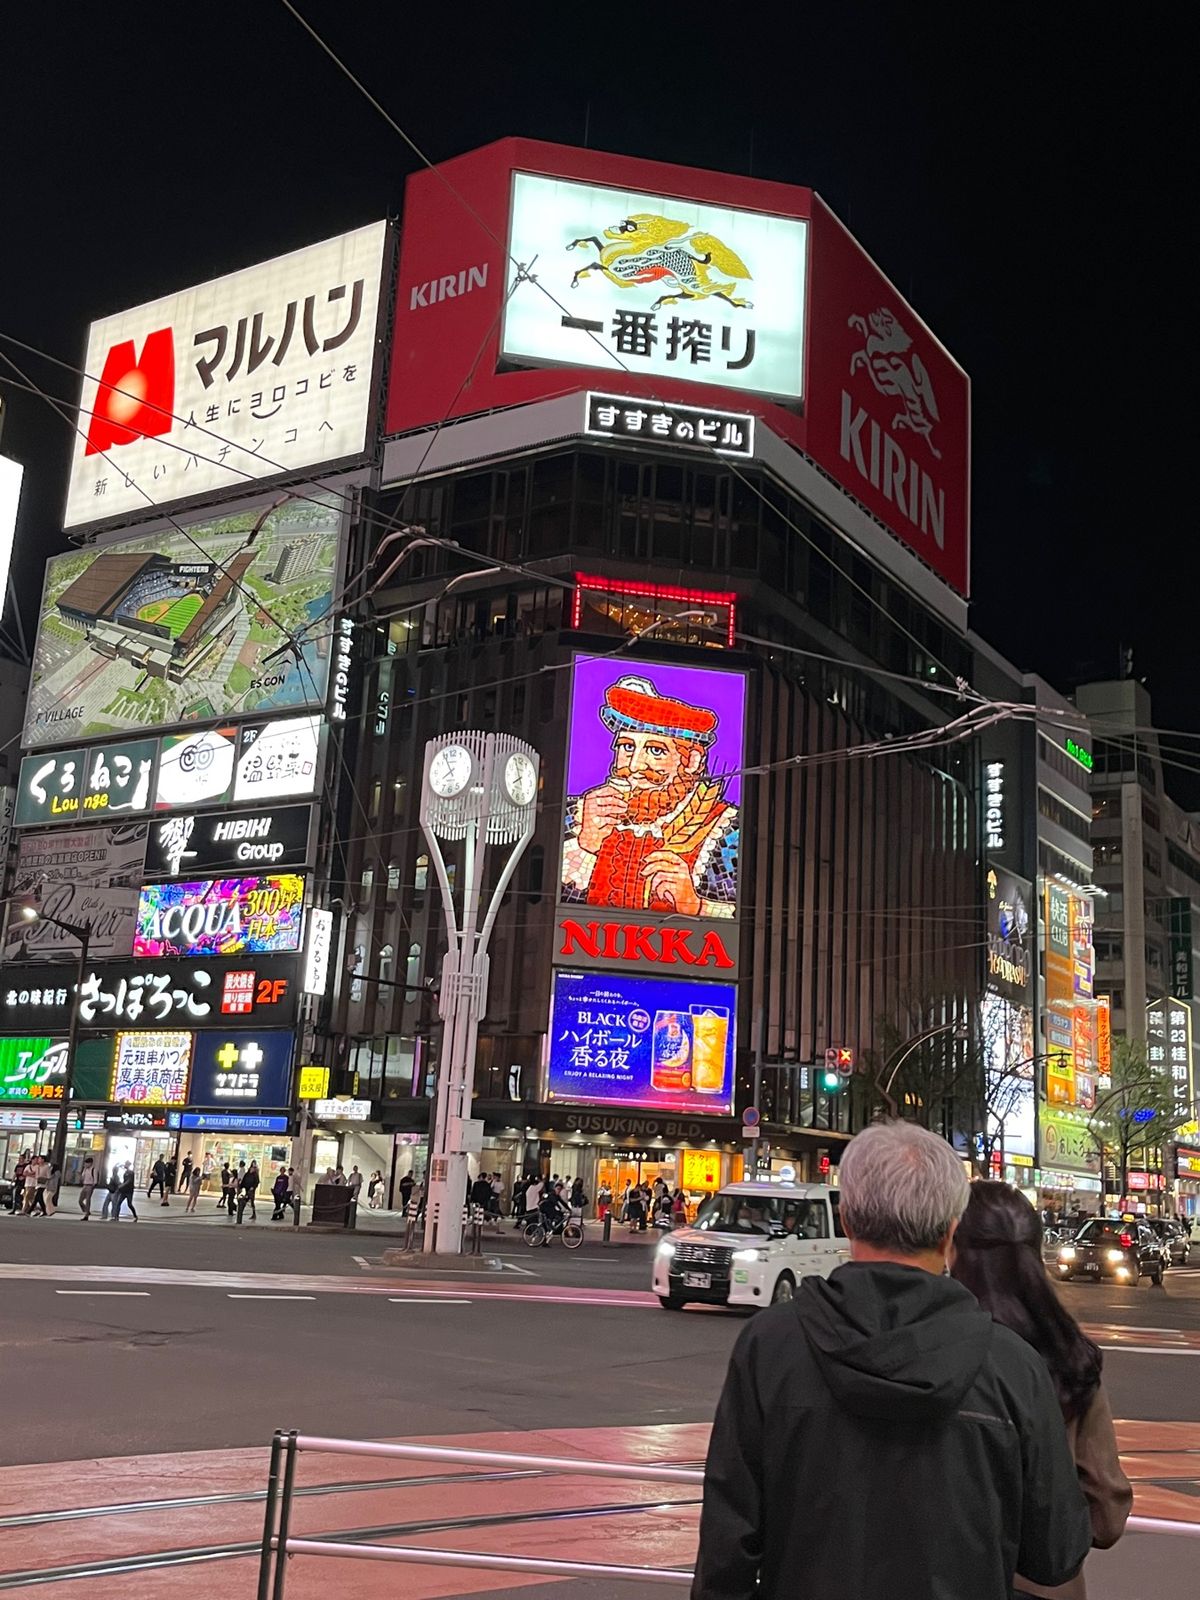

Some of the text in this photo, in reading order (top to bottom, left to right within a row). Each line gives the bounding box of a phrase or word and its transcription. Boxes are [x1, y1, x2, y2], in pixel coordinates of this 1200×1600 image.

[409, 263, 489, 311] KIRIN
[194, 278, 364, 390] マルハン
[561, 308, 757, 371] 一番搾り
[184, 364, 358, 430] 人生にヨロコビを
[597, 406, 742, 446] すすきのビル
[841, 388, 945, 551] KIRIN
[45, 705, 85, 724] VILLAGE
[243, 729, 259, 743] 2F
[30, 752, 133, 805] くろねこ
[214, 817, 273, 841] HIBIKI
[237, 843, 284, 862] Group
[143, 902, 241, 943] ACQUA
[559, 919, 736, 969] NIKKA
[6, 989, 67, 1006] 北の味紀行
[74, 971, 211, 1022] さっぽろっこ
[256, 980, 288, 1003] 2F
[577, 1011, 627, 1028] BLACK
[559, 1028, 642, 1049] ハイボール
[122, 1050, 180, 1066] 元祖串かつ
[569, 1046, 631, 1070] 香る夜
[564, 1070, 582, 1078] ENJOY
[566, 1114, 706, 1138] SUSUKINO BLD.
